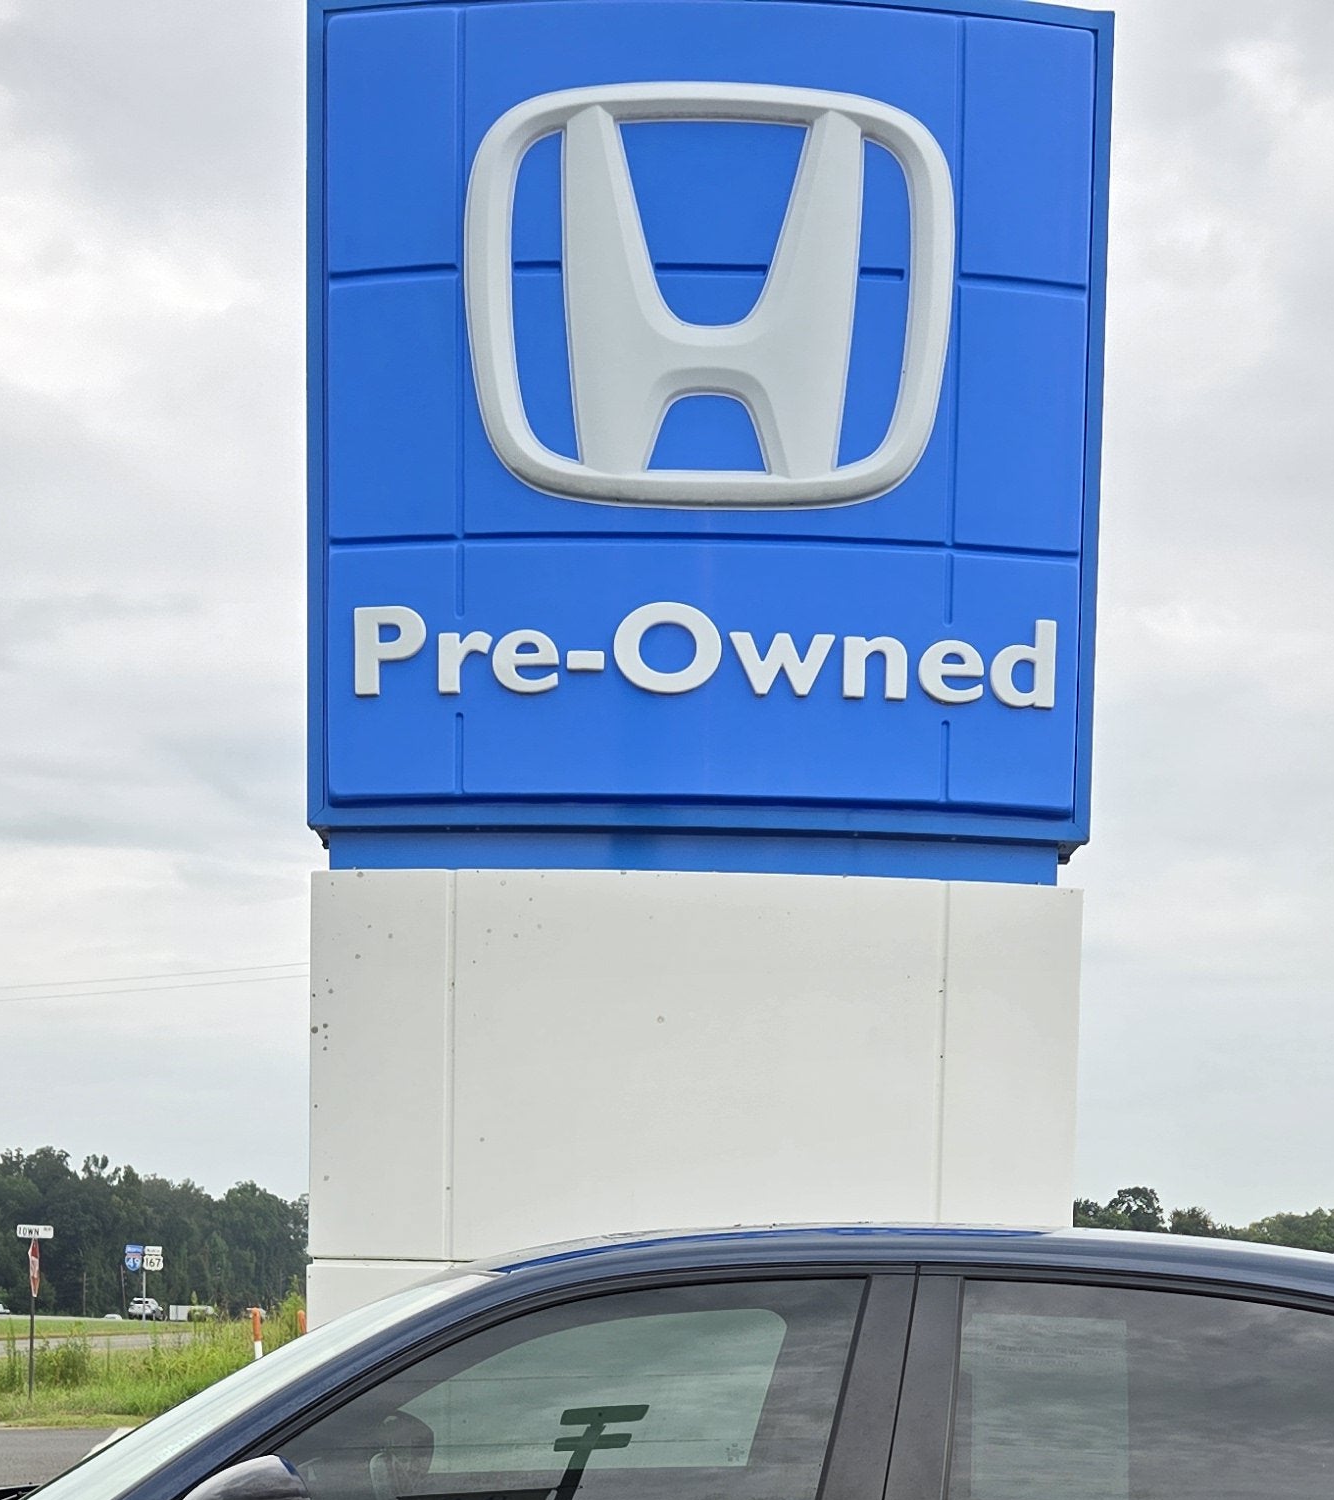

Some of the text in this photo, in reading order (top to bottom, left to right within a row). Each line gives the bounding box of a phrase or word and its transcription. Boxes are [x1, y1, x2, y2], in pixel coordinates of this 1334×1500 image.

[353, 601, 1057, 709] Pre-Owned
[127, 1257, 140, 1268] 49
[145, 1257, 161, 1268] 167
